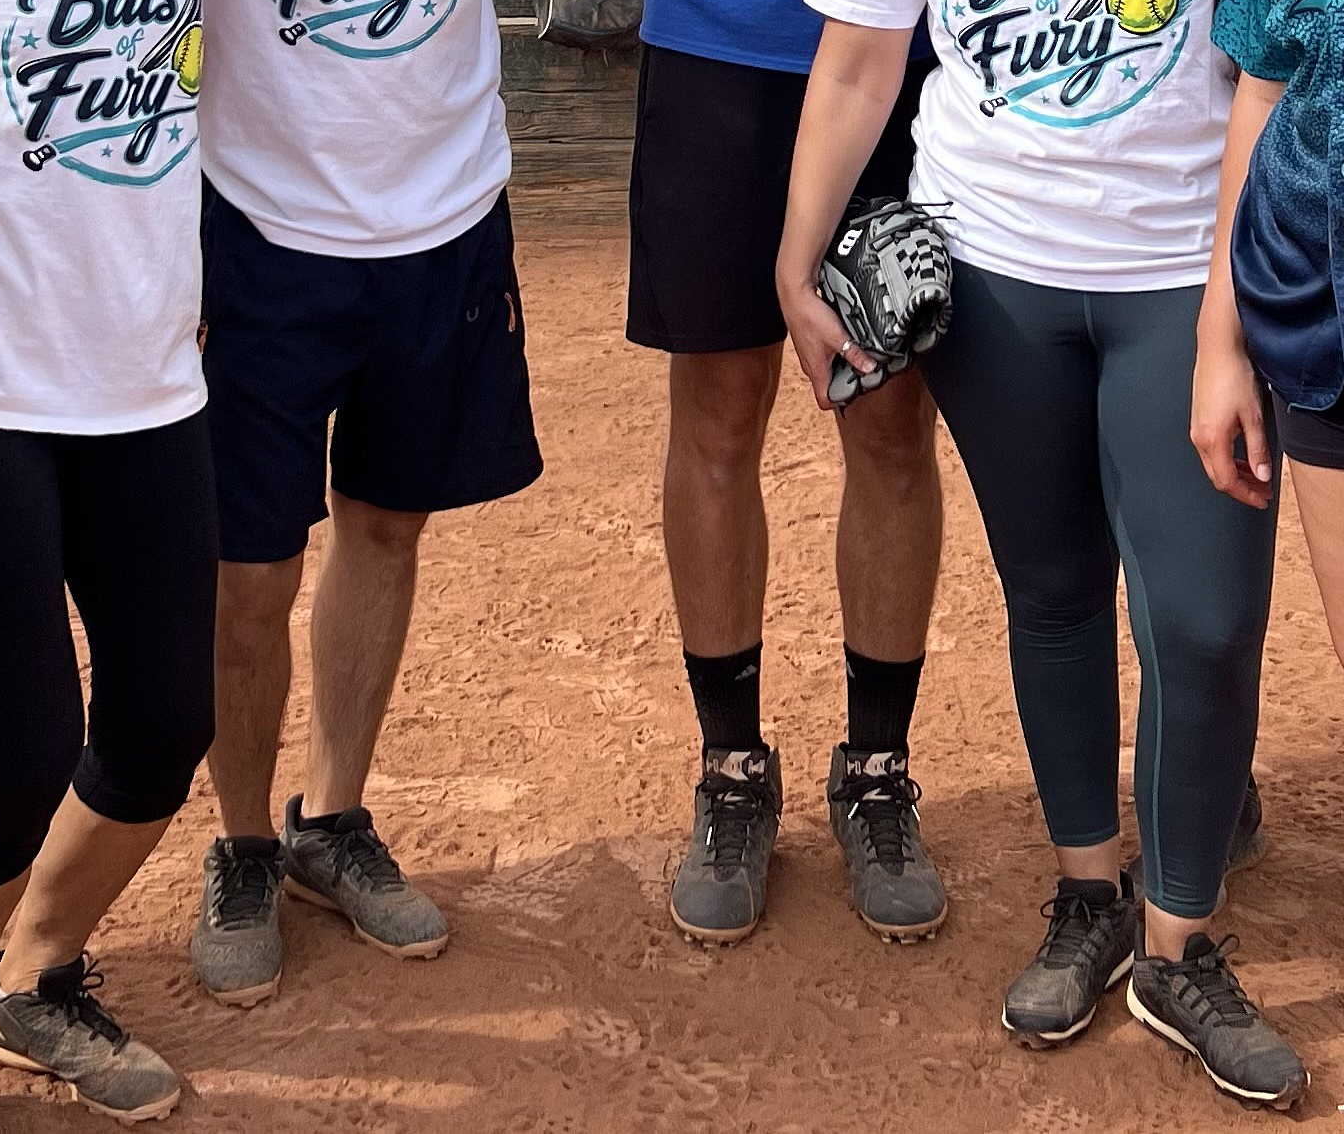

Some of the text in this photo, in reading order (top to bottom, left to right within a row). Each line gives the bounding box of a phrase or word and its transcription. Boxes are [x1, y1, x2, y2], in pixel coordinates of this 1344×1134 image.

[116, 28, 145, 61] of
[957, 6, 1162, 107] Fury
[16, 48, 197, 165] Fury
